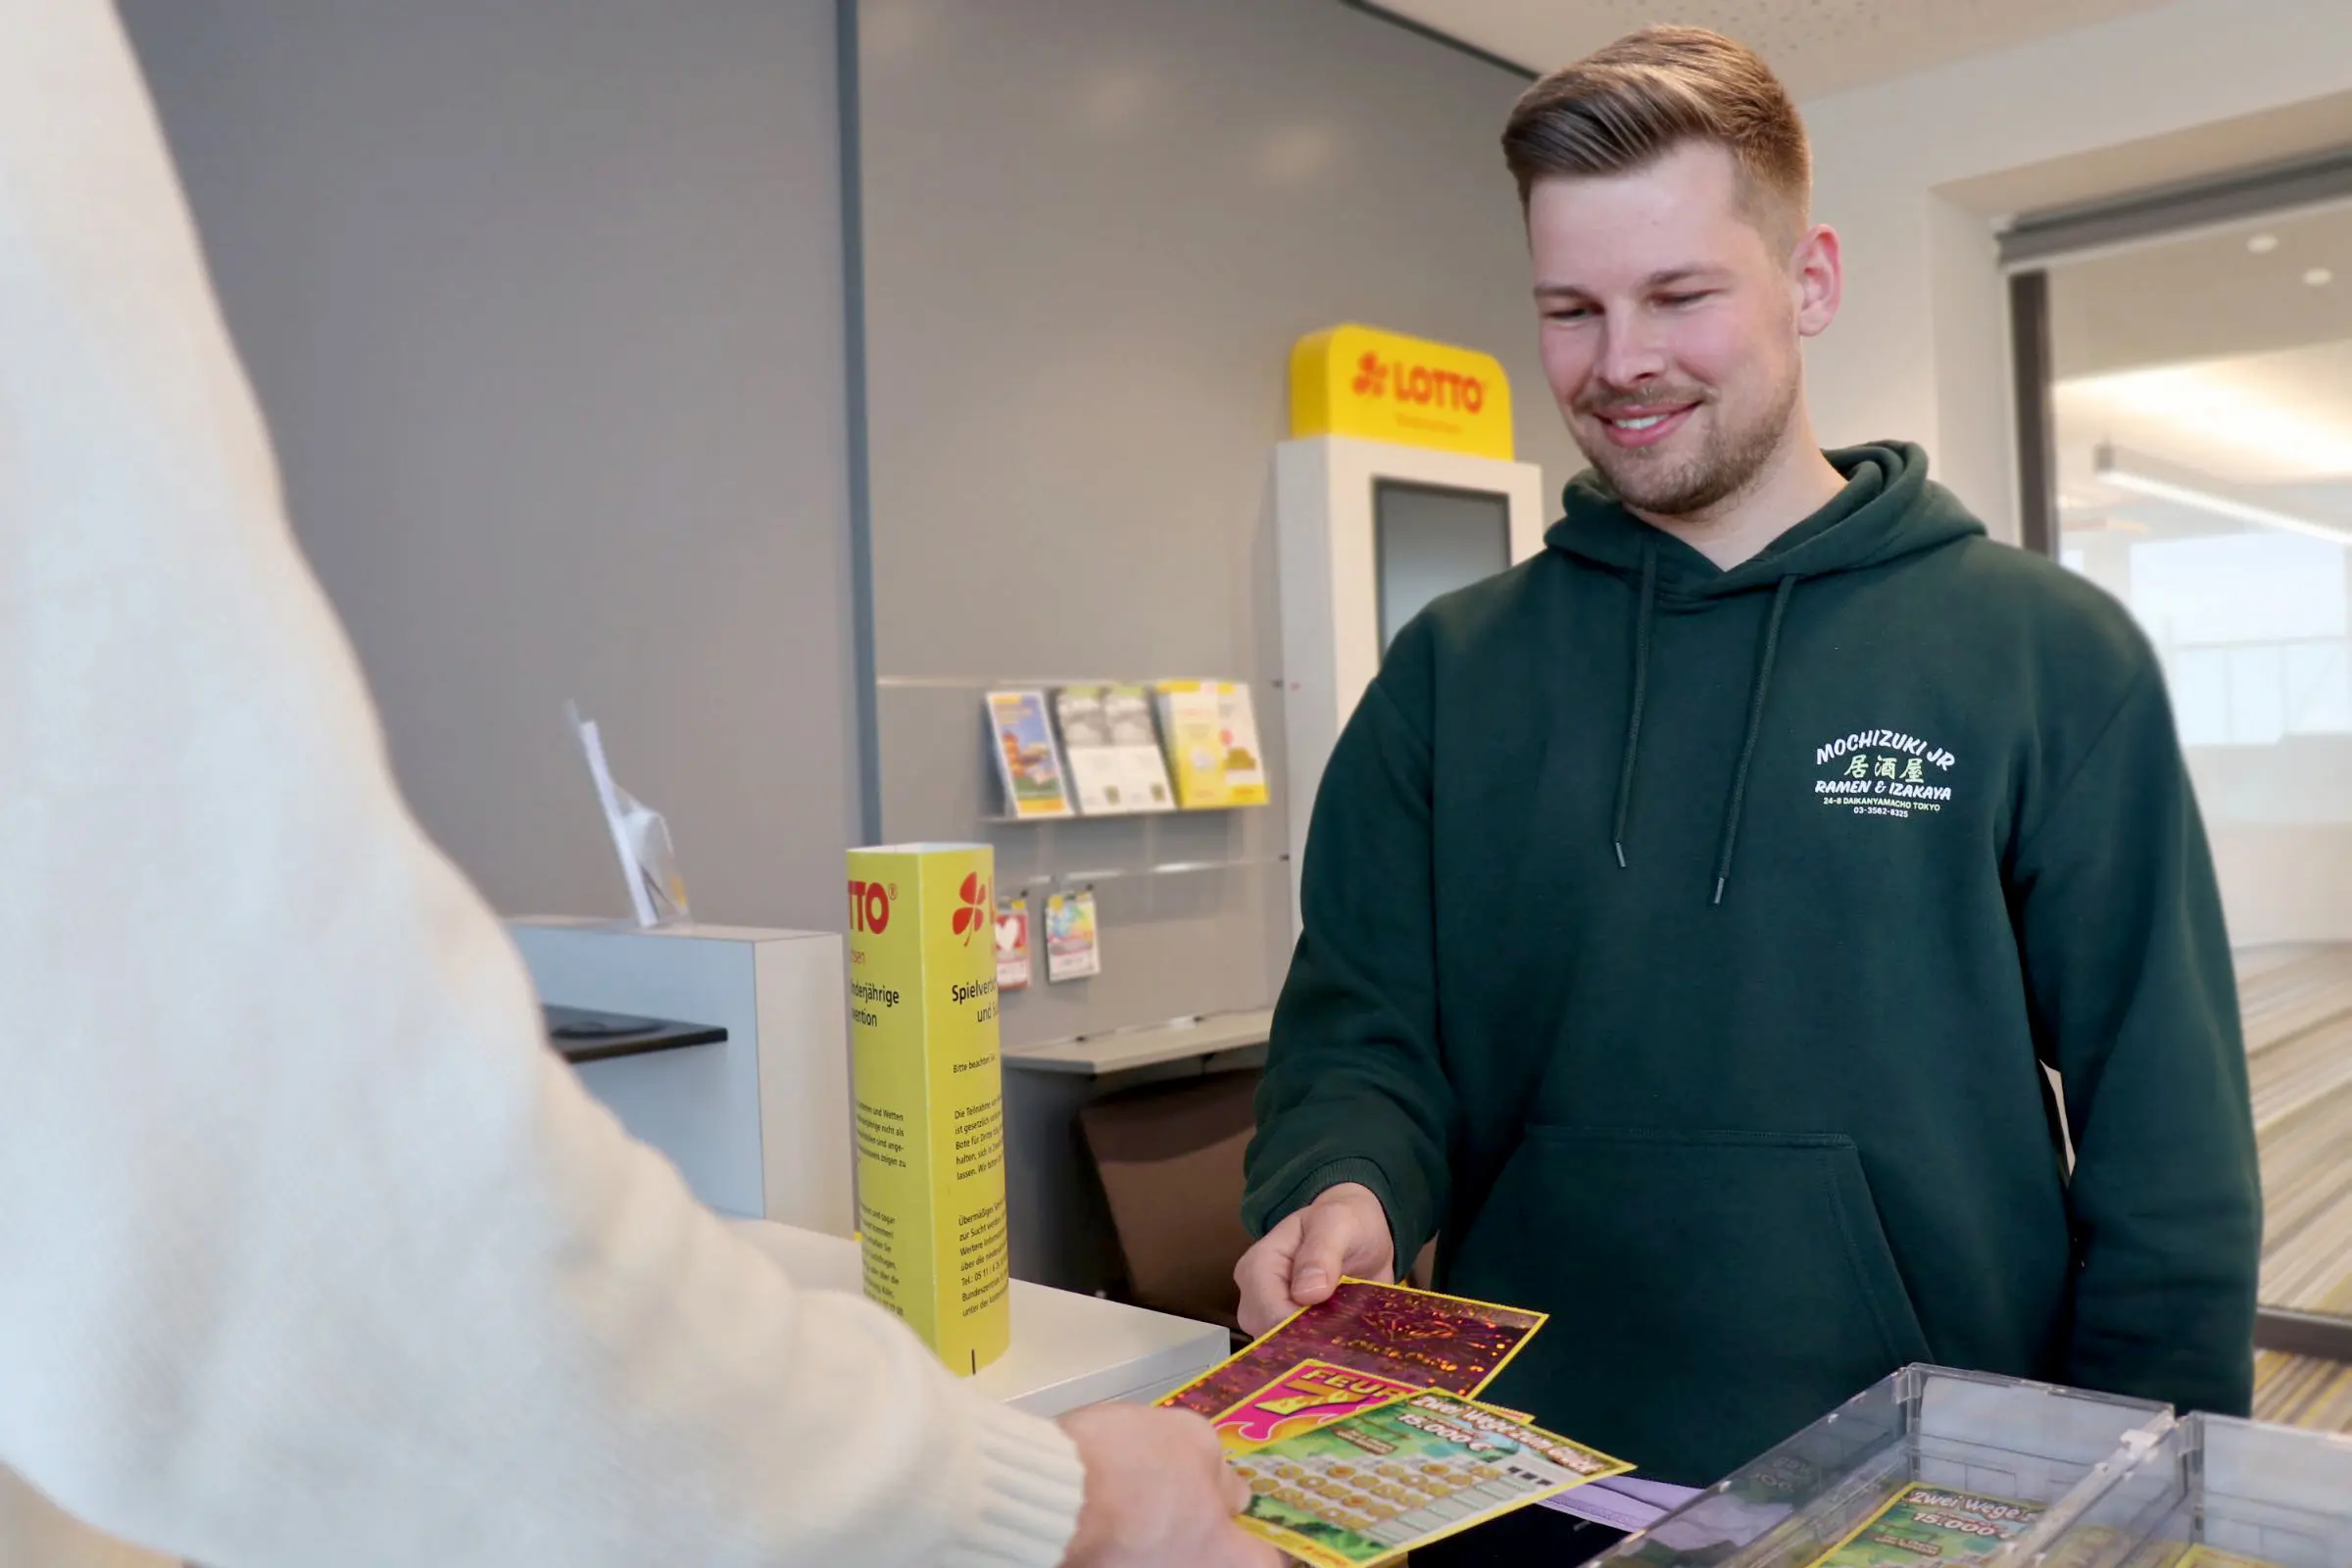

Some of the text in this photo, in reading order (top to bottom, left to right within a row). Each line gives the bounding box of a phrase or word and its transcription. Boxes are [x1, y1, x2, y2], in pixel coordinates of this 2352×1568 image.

[1394, 361, 1485, 416] LOTTO
[1816, 729, 1956, 771] MOCHIZUKI JR
[1843, 754, 1924, 784] 居酒屋
[1815, 780, 1952, 801] RAMEN & IZAKAYA
[1842, 797, 1912, 809] DAIKANYAMACHO
[1913, 802, 1941, 811] TOKYO
[977, 1001, 992, 1023] und
[953, 1062, 967, 1074] Bitte
[955, 1108, 965, 1120] Die
[955, 1125, 963, 1136] ist
[956, 1139, 970, 1151] Bote
[1910, 1490, 1963, 1509] Zwei
[1965, 1498, 2020, 1520] Wege
[1913, 1512, 1996, 1537] 15.000
